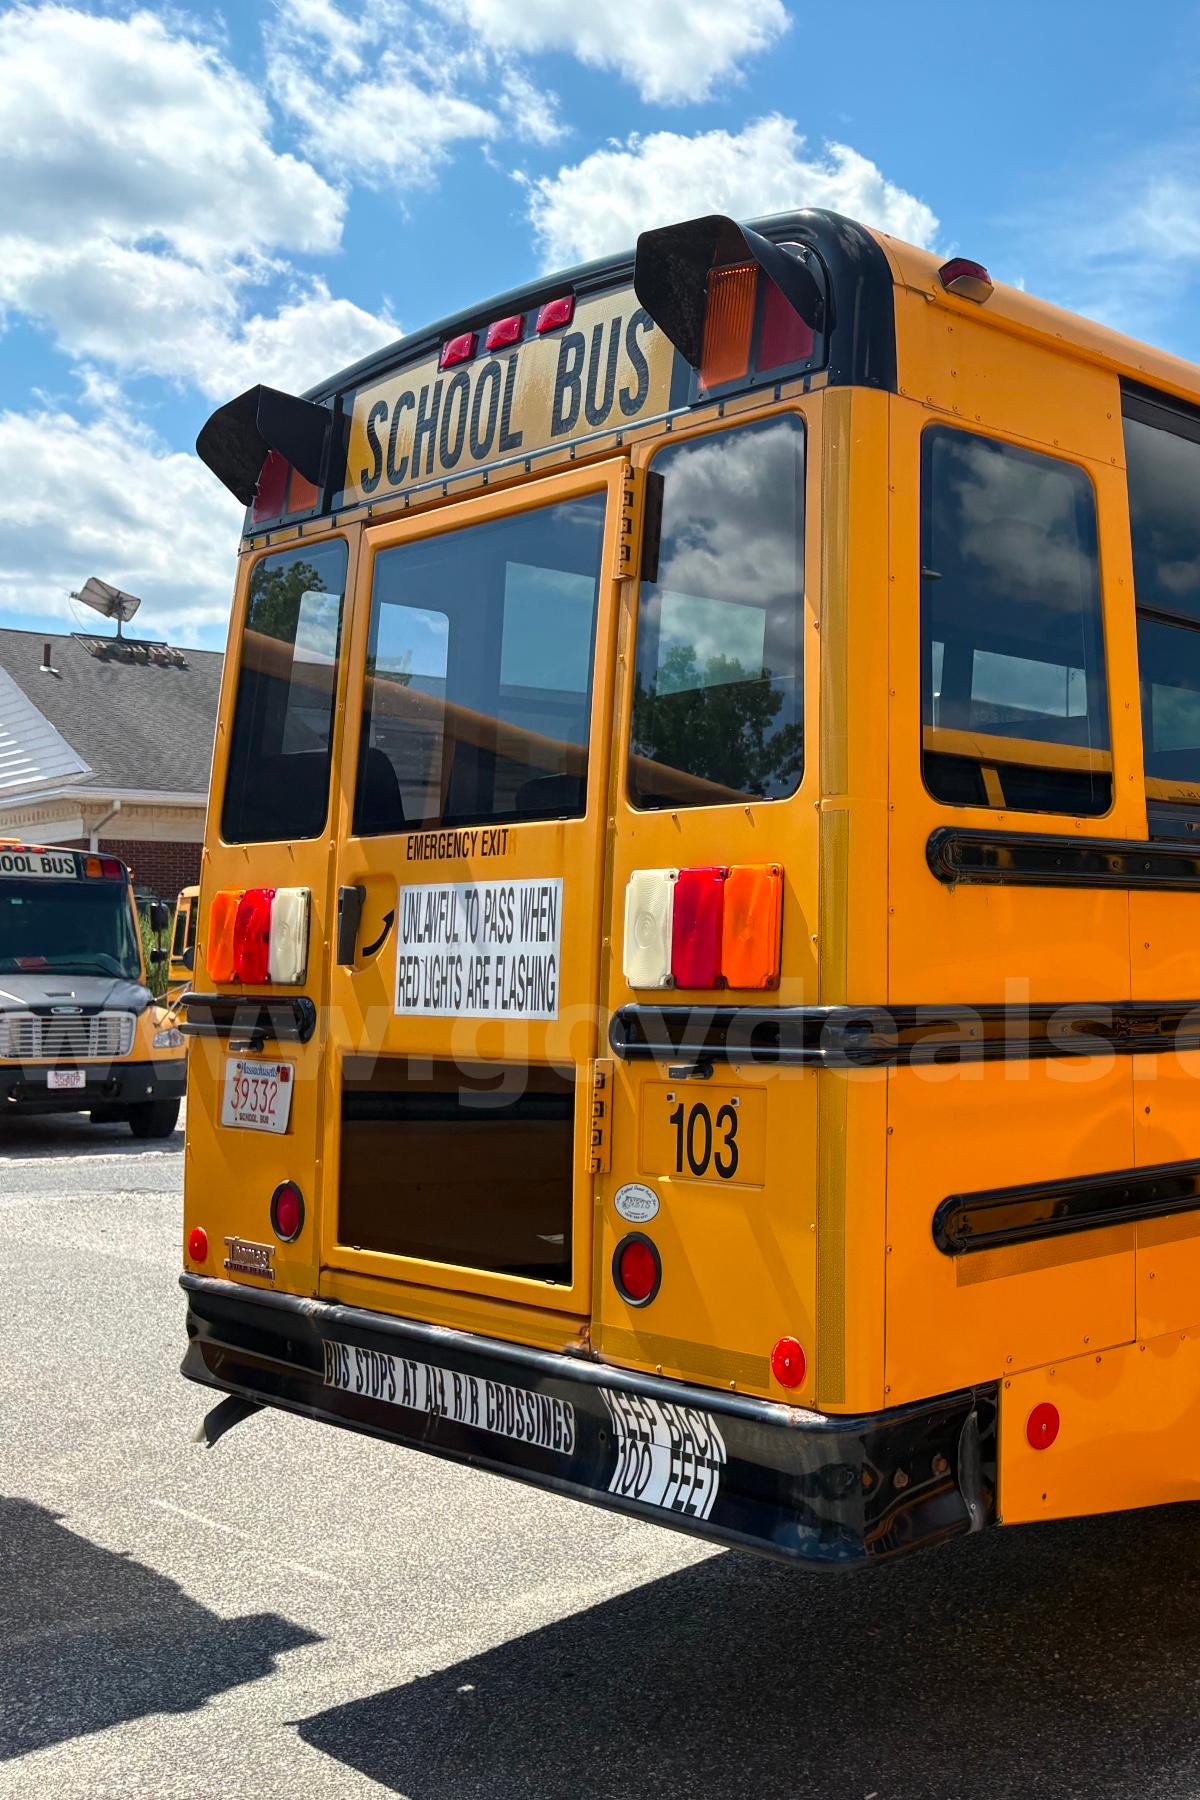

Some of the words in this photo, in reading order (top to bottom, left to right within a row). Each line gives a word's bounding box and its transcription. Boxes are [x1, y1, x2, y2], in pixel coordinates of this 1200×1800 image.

[360, 353, 523, 494] SCHOOL
[551, 308, 655, 438] BUS
[0, 855, 38, 873] OOL
[40, 857, 75, 874] BUS
[406, 832, 479, 861] EMERGENCY
[481, 828, 509, 857] EXIT
[403, 890, 458, 944] UNLAWFUL
[464, 888, 480, 944] TO
[483, 886, 515, 944] PASS
[520, 886, 558, 943] WHEN
[397, 955, 420, 1007] RED
[423, 954, 463, 1011] LIGHTS
[466, 955, 490, 1010] ARE
[494, 954, 556, 1013] FLASHING
[230, 1077, 278, 1115] 39332
[669, 1102, 739, 1179] 103
[323, 1340, 350, 1388] BUS
[355, 1347, 396, 1401] STOPS
[402, 1358, 418, 1408] AT
[424, 1364, 448, 1416] ALL
[453, 1374, 480, 1426] R/R
[485, 1384, 575, 1454] CROSSINGS
[602, 1387, 656, 1443] KEEP
[661, 1400, 727, 1463] BACK
[608, 1435, 653, 1499] 100
[660, 1450, 720, 1520] FEET
